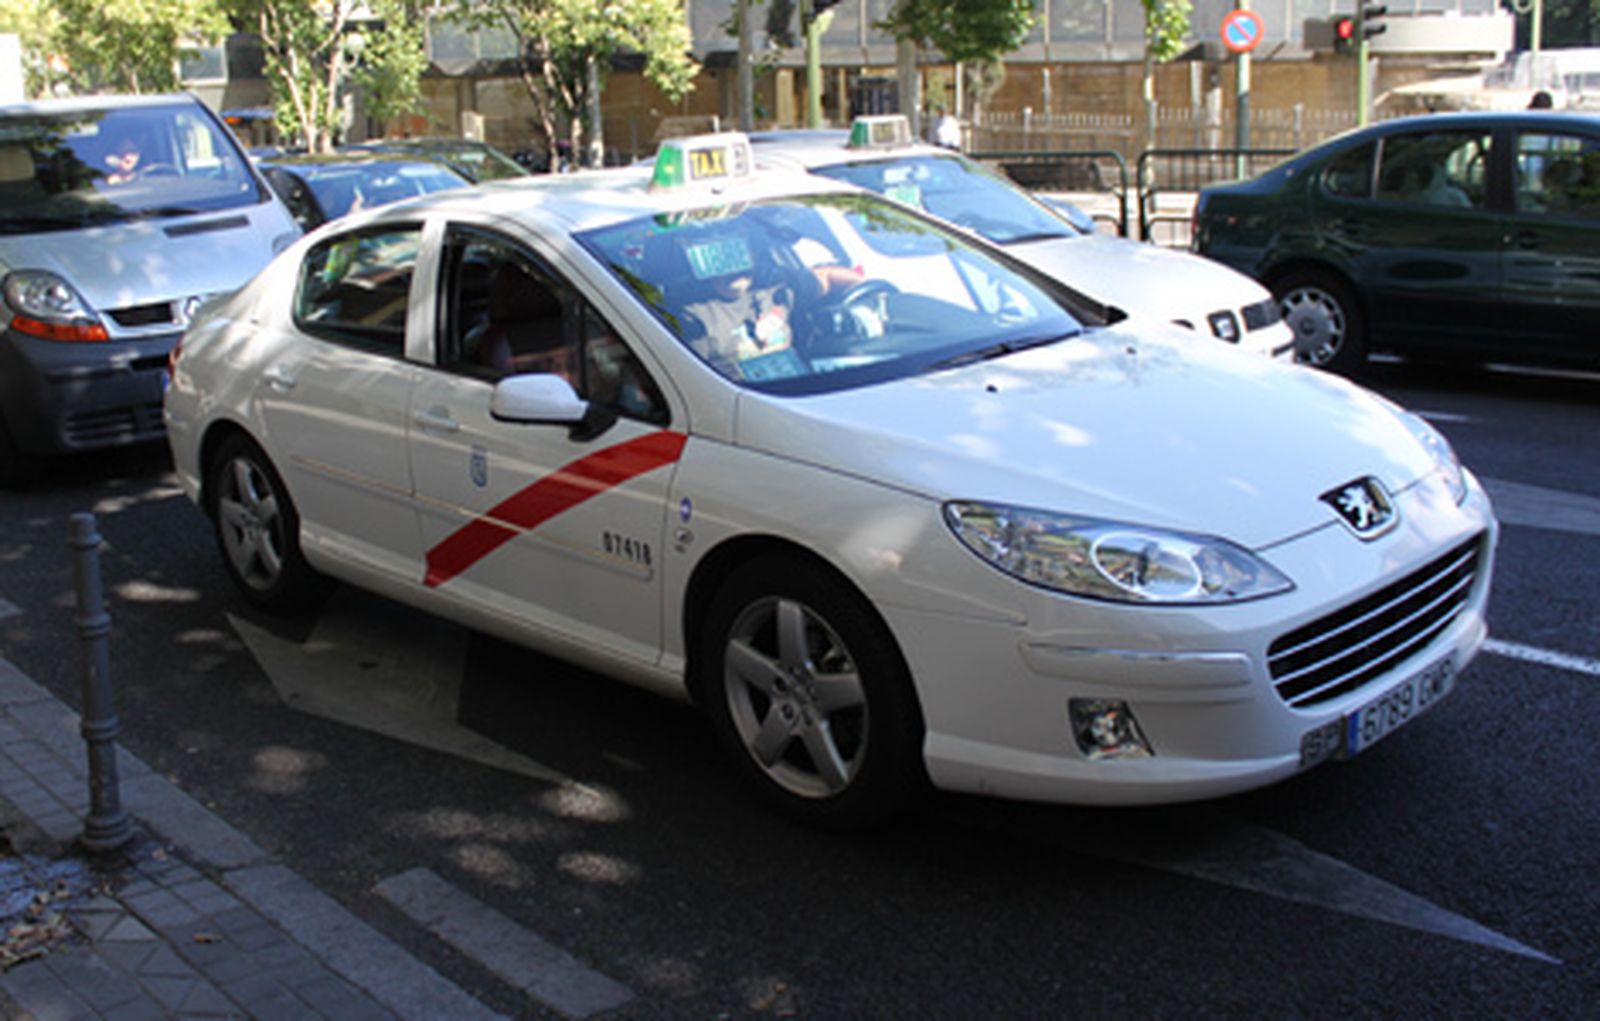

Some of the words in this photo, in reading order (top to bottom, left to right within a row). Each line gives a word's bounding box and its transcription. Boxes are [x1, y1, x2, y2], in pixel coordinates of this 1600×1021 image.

[689, 147, 728, 179] TAXI
[602, 530, 652, 566] 07418
[1362, 683, 1415, 742] 6789
